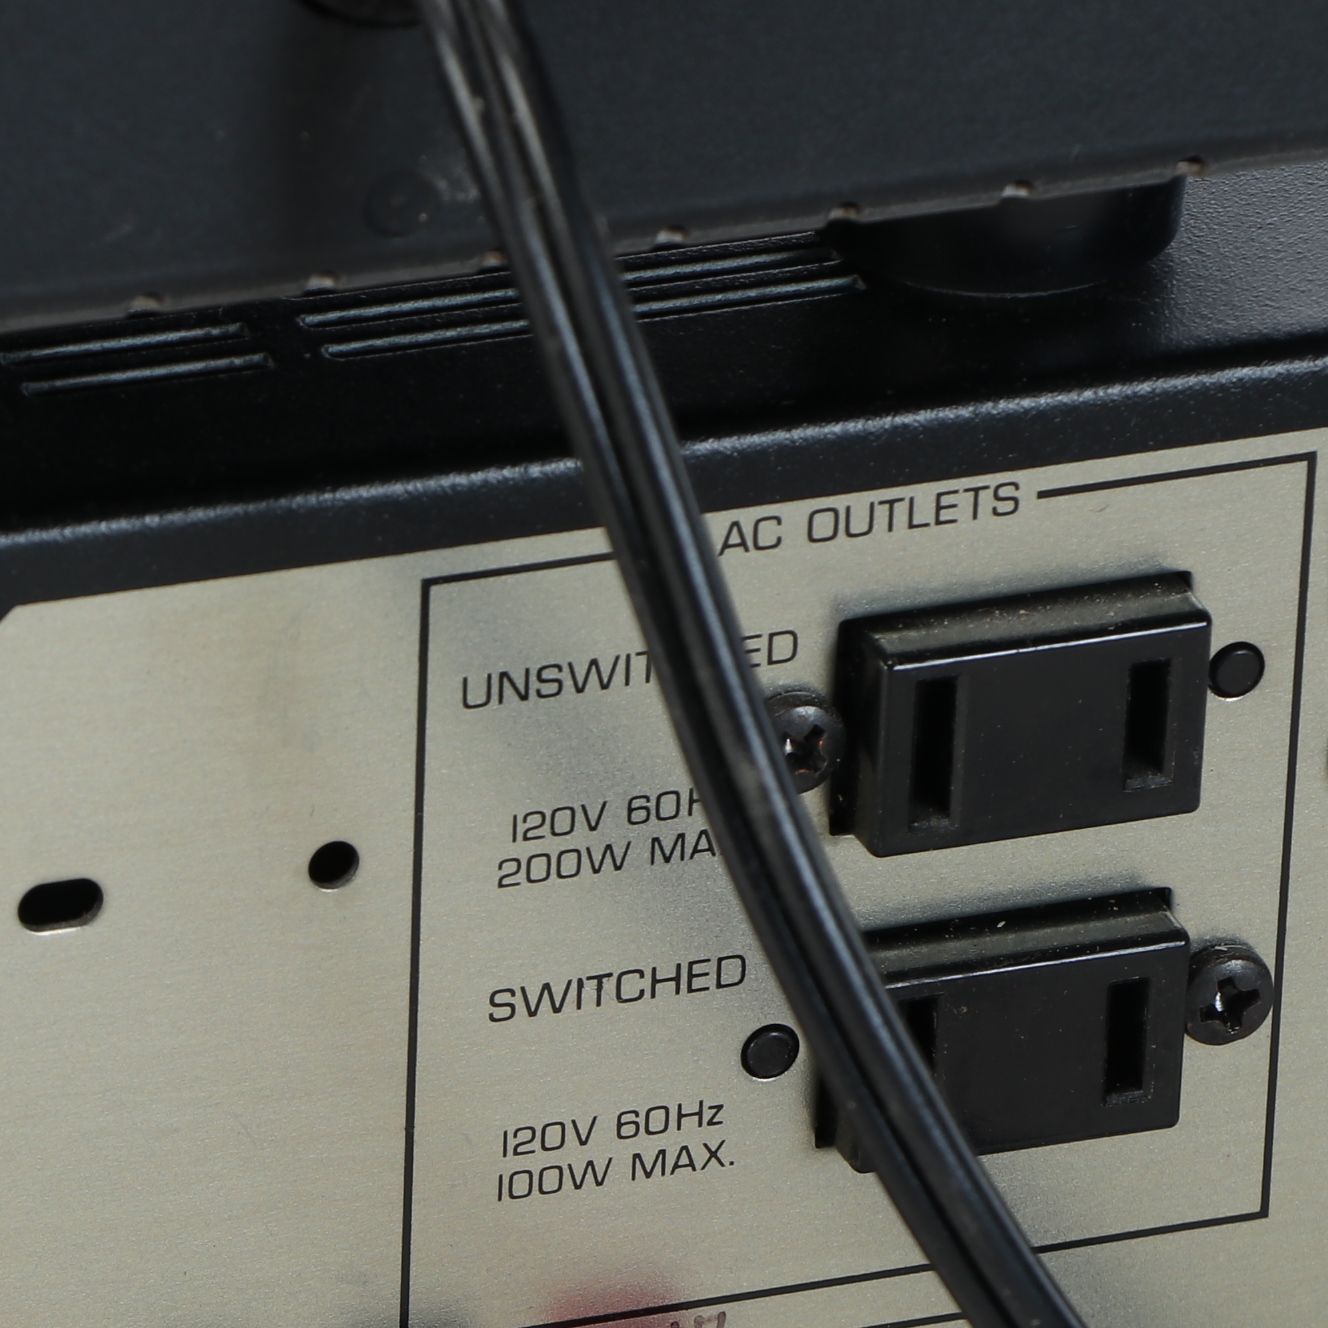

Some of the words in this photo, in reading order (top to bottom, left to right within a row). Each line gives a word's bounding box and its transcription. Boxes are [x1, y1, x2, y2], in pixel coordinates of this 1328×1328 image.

[718, 516, 783, 556] AC
[806, 482, 1020, 544] OUTLETS
[462, 629, 799, 709] UNSWITED
[511, 801, 608, 843] 120V
[497, 840, 632, 889] 200W
[650, 828, 718, 866] MA
[488, 954, 747, 1023] SWITCHED
[502, 1116, 598, 1158] 120V
[615, 1100, 725, 1141] 60Hz
[497, 1157, 612, 1203] 100W
[630, 1140, 735, 1182] MAX.
